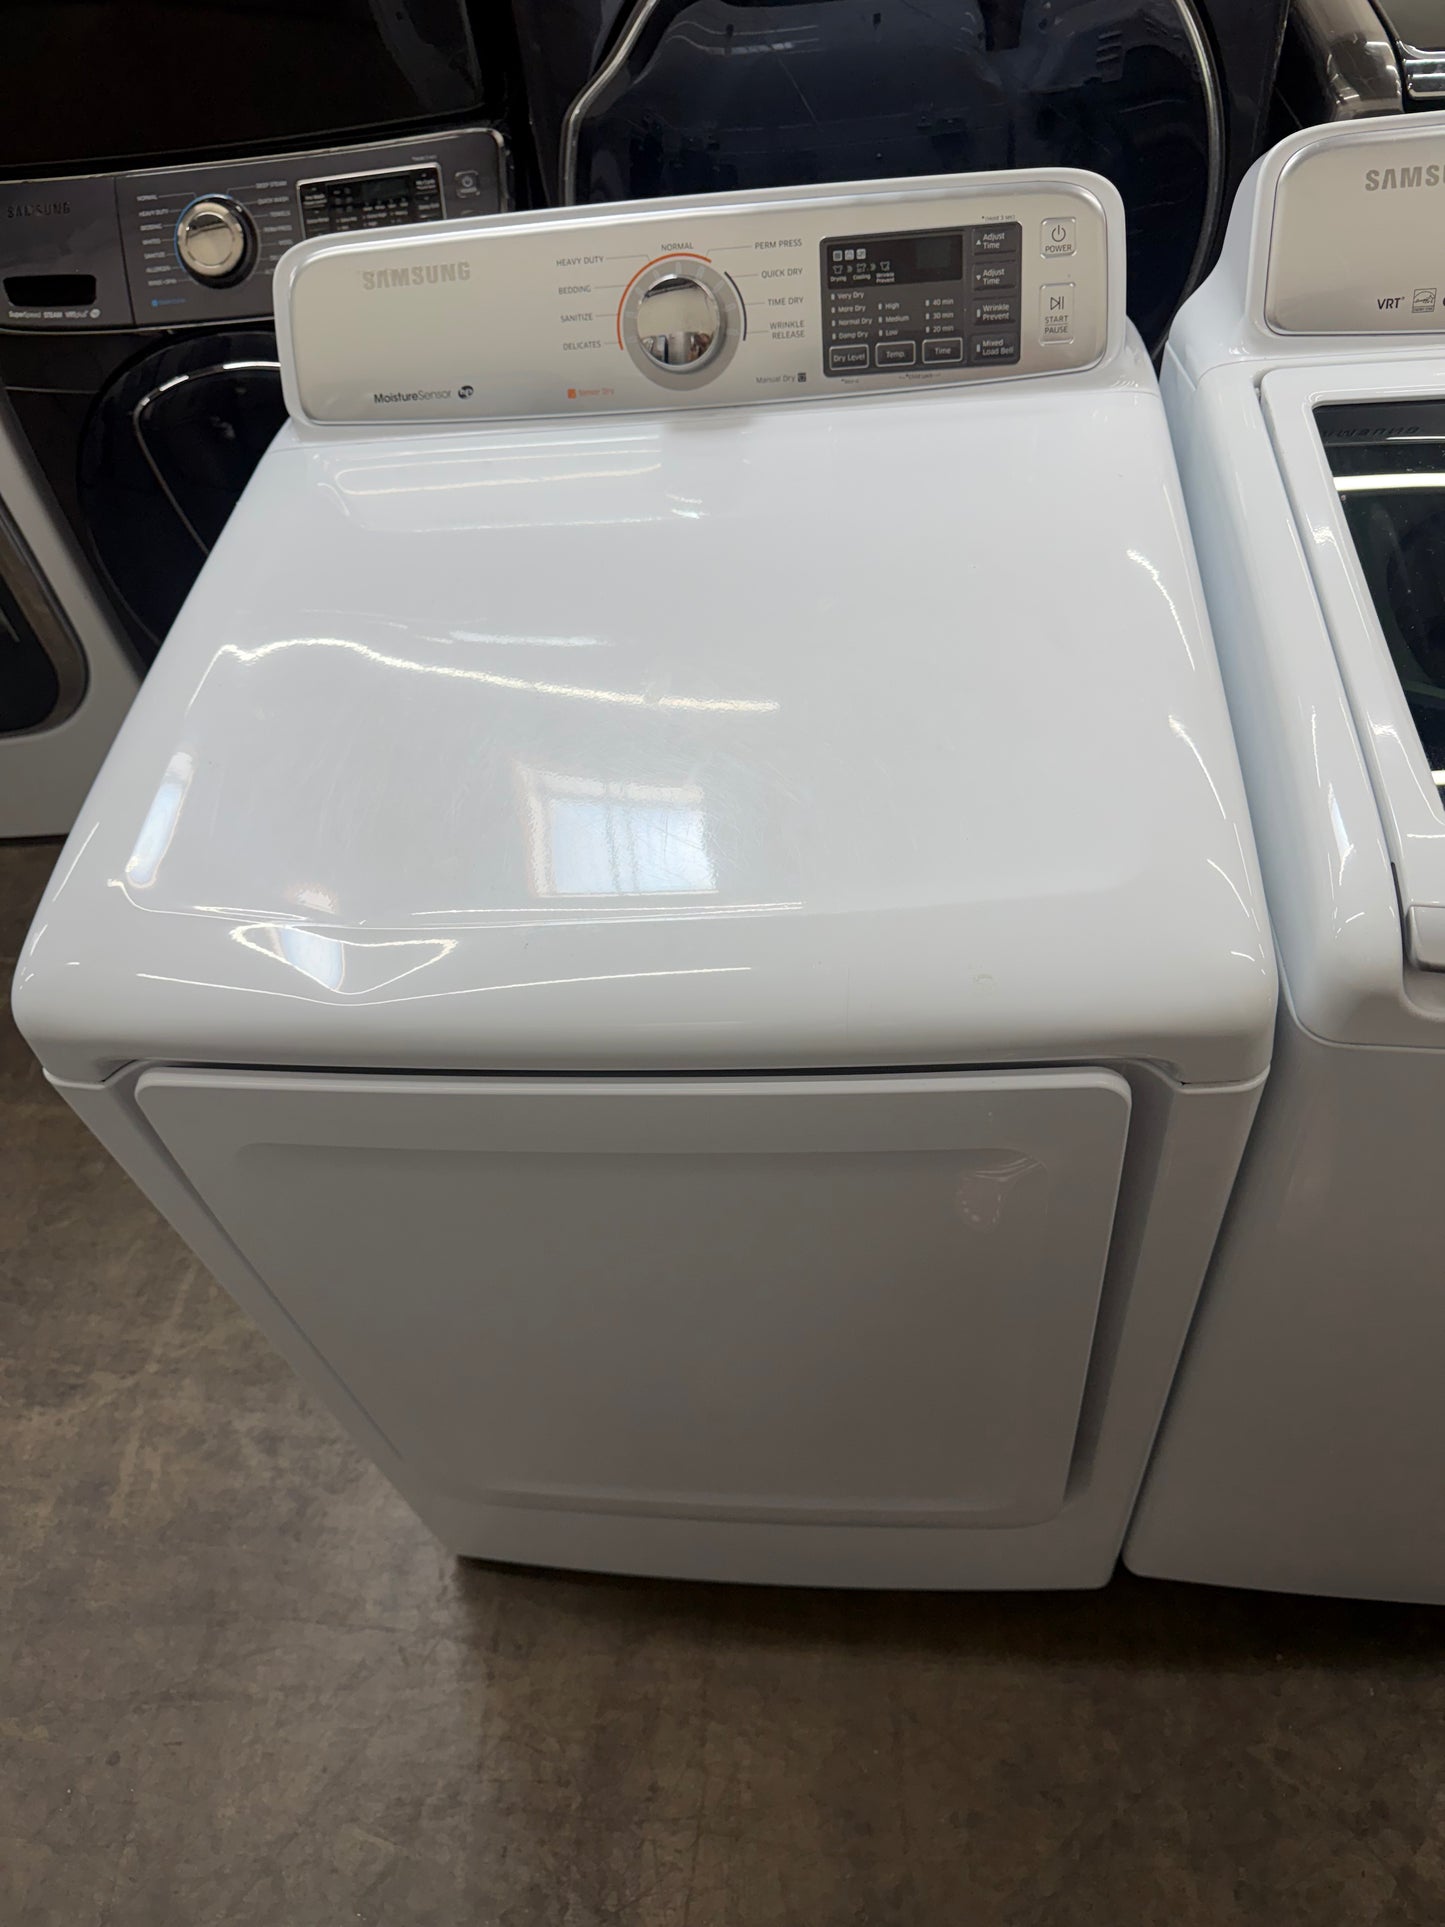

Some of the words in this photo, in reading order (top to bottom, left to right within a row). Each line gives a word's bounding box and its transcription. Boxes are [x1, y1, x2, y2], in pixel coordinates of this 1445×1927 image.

[1365, 165, 1445, 191] SAMS
[983, 233, 1005, 242] Adjust
[661, 242, 693, 251] NORMAL
[754, 241, 777, 250] PERM
[778, 239, 803, 248] PRESS
[1045, 244, 1072, 253] POWER
[556, 257, 583, 267] HEAVY
[584, 256, 604, 265] DUTY
[362, 261, 471, 290] SAMSUNG
[761, 269, 785, 279] QUICK
[787, 268, 803, 277] DRY
[983, 269, 1005, 278] Adjust
[558, 285, 591, 295] BEDDING
[853, 291, 865, 299] Dry
[768, 298, 786, 306] TIME
[788, 296, 804, 305] DRY
[983, 304, 1010, 312] Wrinkle
[560, 313, 593, 323] SANITIZE
[861, 317, 873, 325] Dry
[983, 313, 1010, 321] Prevent
[1044, 315, 1068, 323] START
[770, 320, 805, 330] WRINKLE
[772, 330, 805, 339] RELEASE
[1044, 326, 1068, 334] PAUSE
[857, 331, 868, 339] Dry
[563, 341, 601, 350] DELICATES
[982, 339, 1004, 347] Mixed
[935, 347, 952, 355] Time
[982, 348, 999, 356] Load
[833, 355, 846, 363] Dry
[847, 353, 866, 361] Level
[756, 376, 781, 384] Manual
[783, 375, 796, 385] Dry
[374, 389, 452, 403] MoistureSensor
